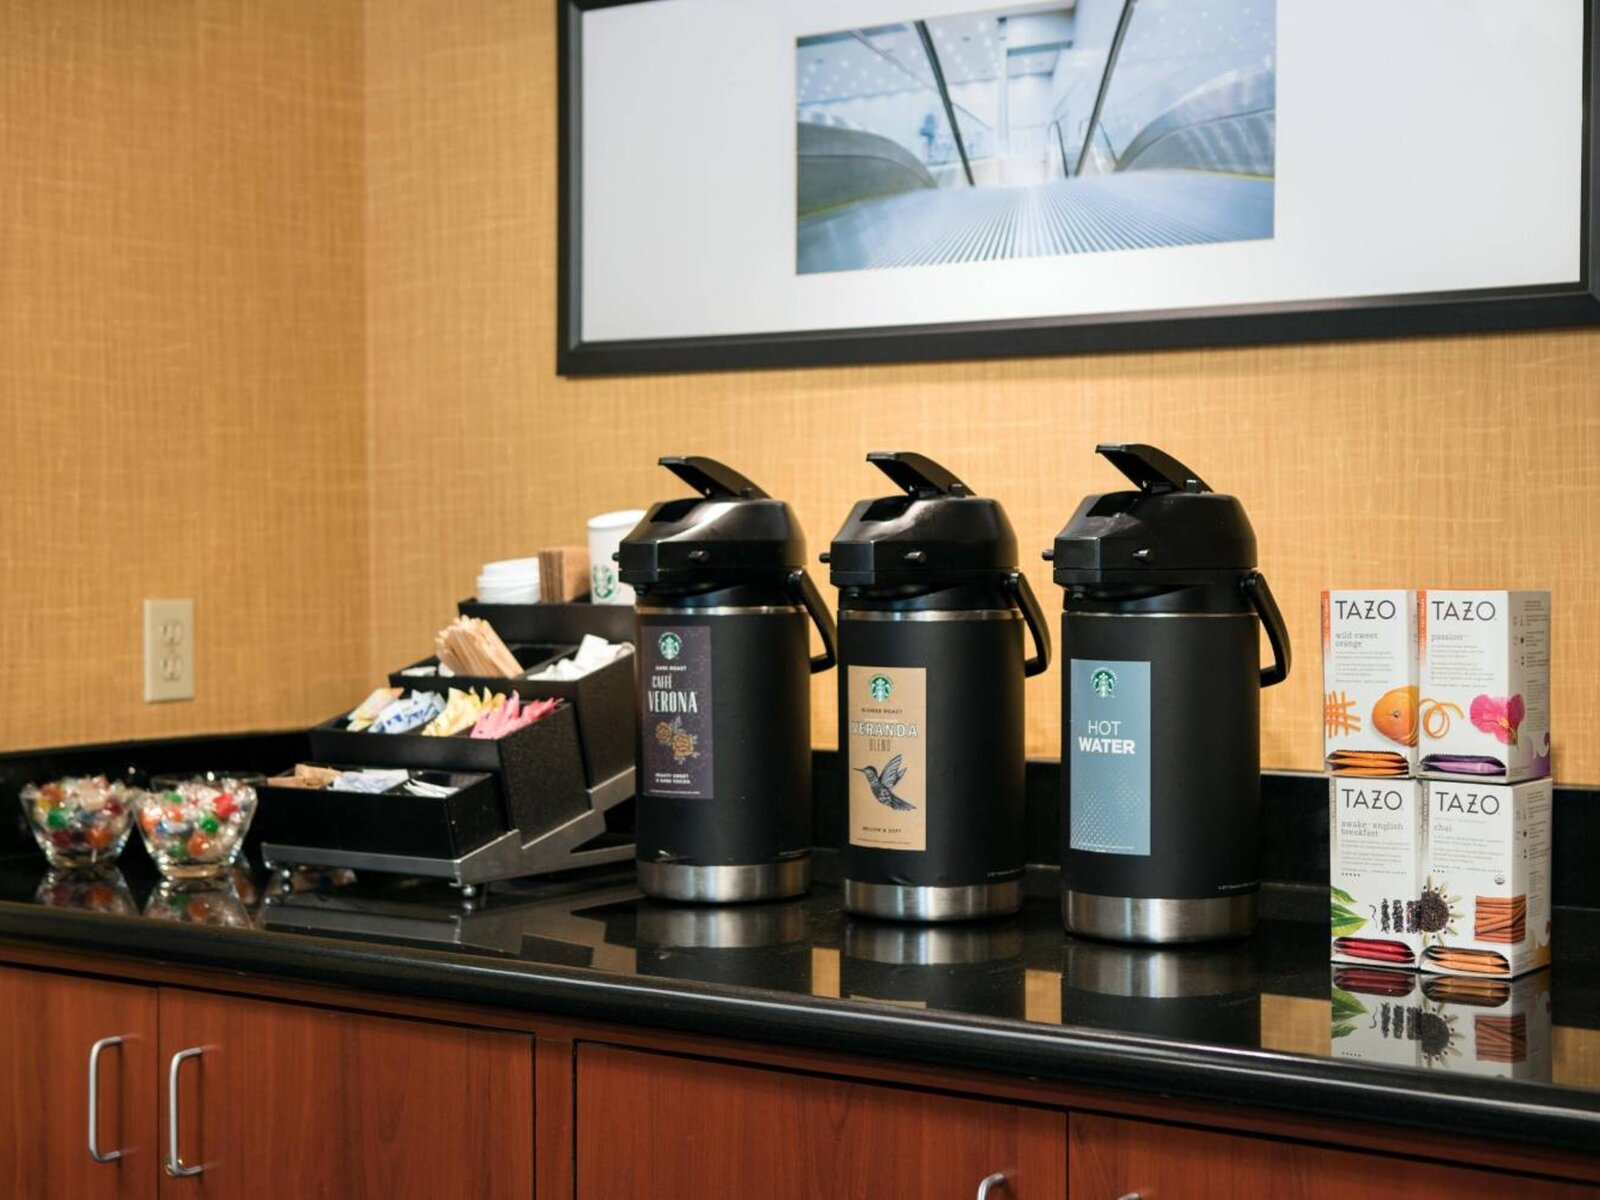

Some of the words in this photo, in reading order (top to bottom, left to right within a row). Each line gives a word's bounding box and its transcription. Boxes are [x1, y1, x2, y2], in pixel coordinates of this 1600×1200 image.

[1334, 599, 1396, 620] TAZO
[1431, 600, 1496, 621] TAZO
[1335, 631, 1352, 640] wild
[1354, 632, 1378, 640] sweet
[1431, 632, 1463, 643] passion
[1335, 641, 1363, 649] orange
[648, 690, 698, 713] VERONA
[1088, 719, 1122, 736] HOT
[1078, 736, 1136, 755] WATER
[1341, 788, 1403, 811] TAZO
[1435, 791, 1500, 815] TAZO
[1341, 828, 1379, 837] breakfast
[1372, 821, 1404, 832] english
[1433, 823, 1453, 833] chai
